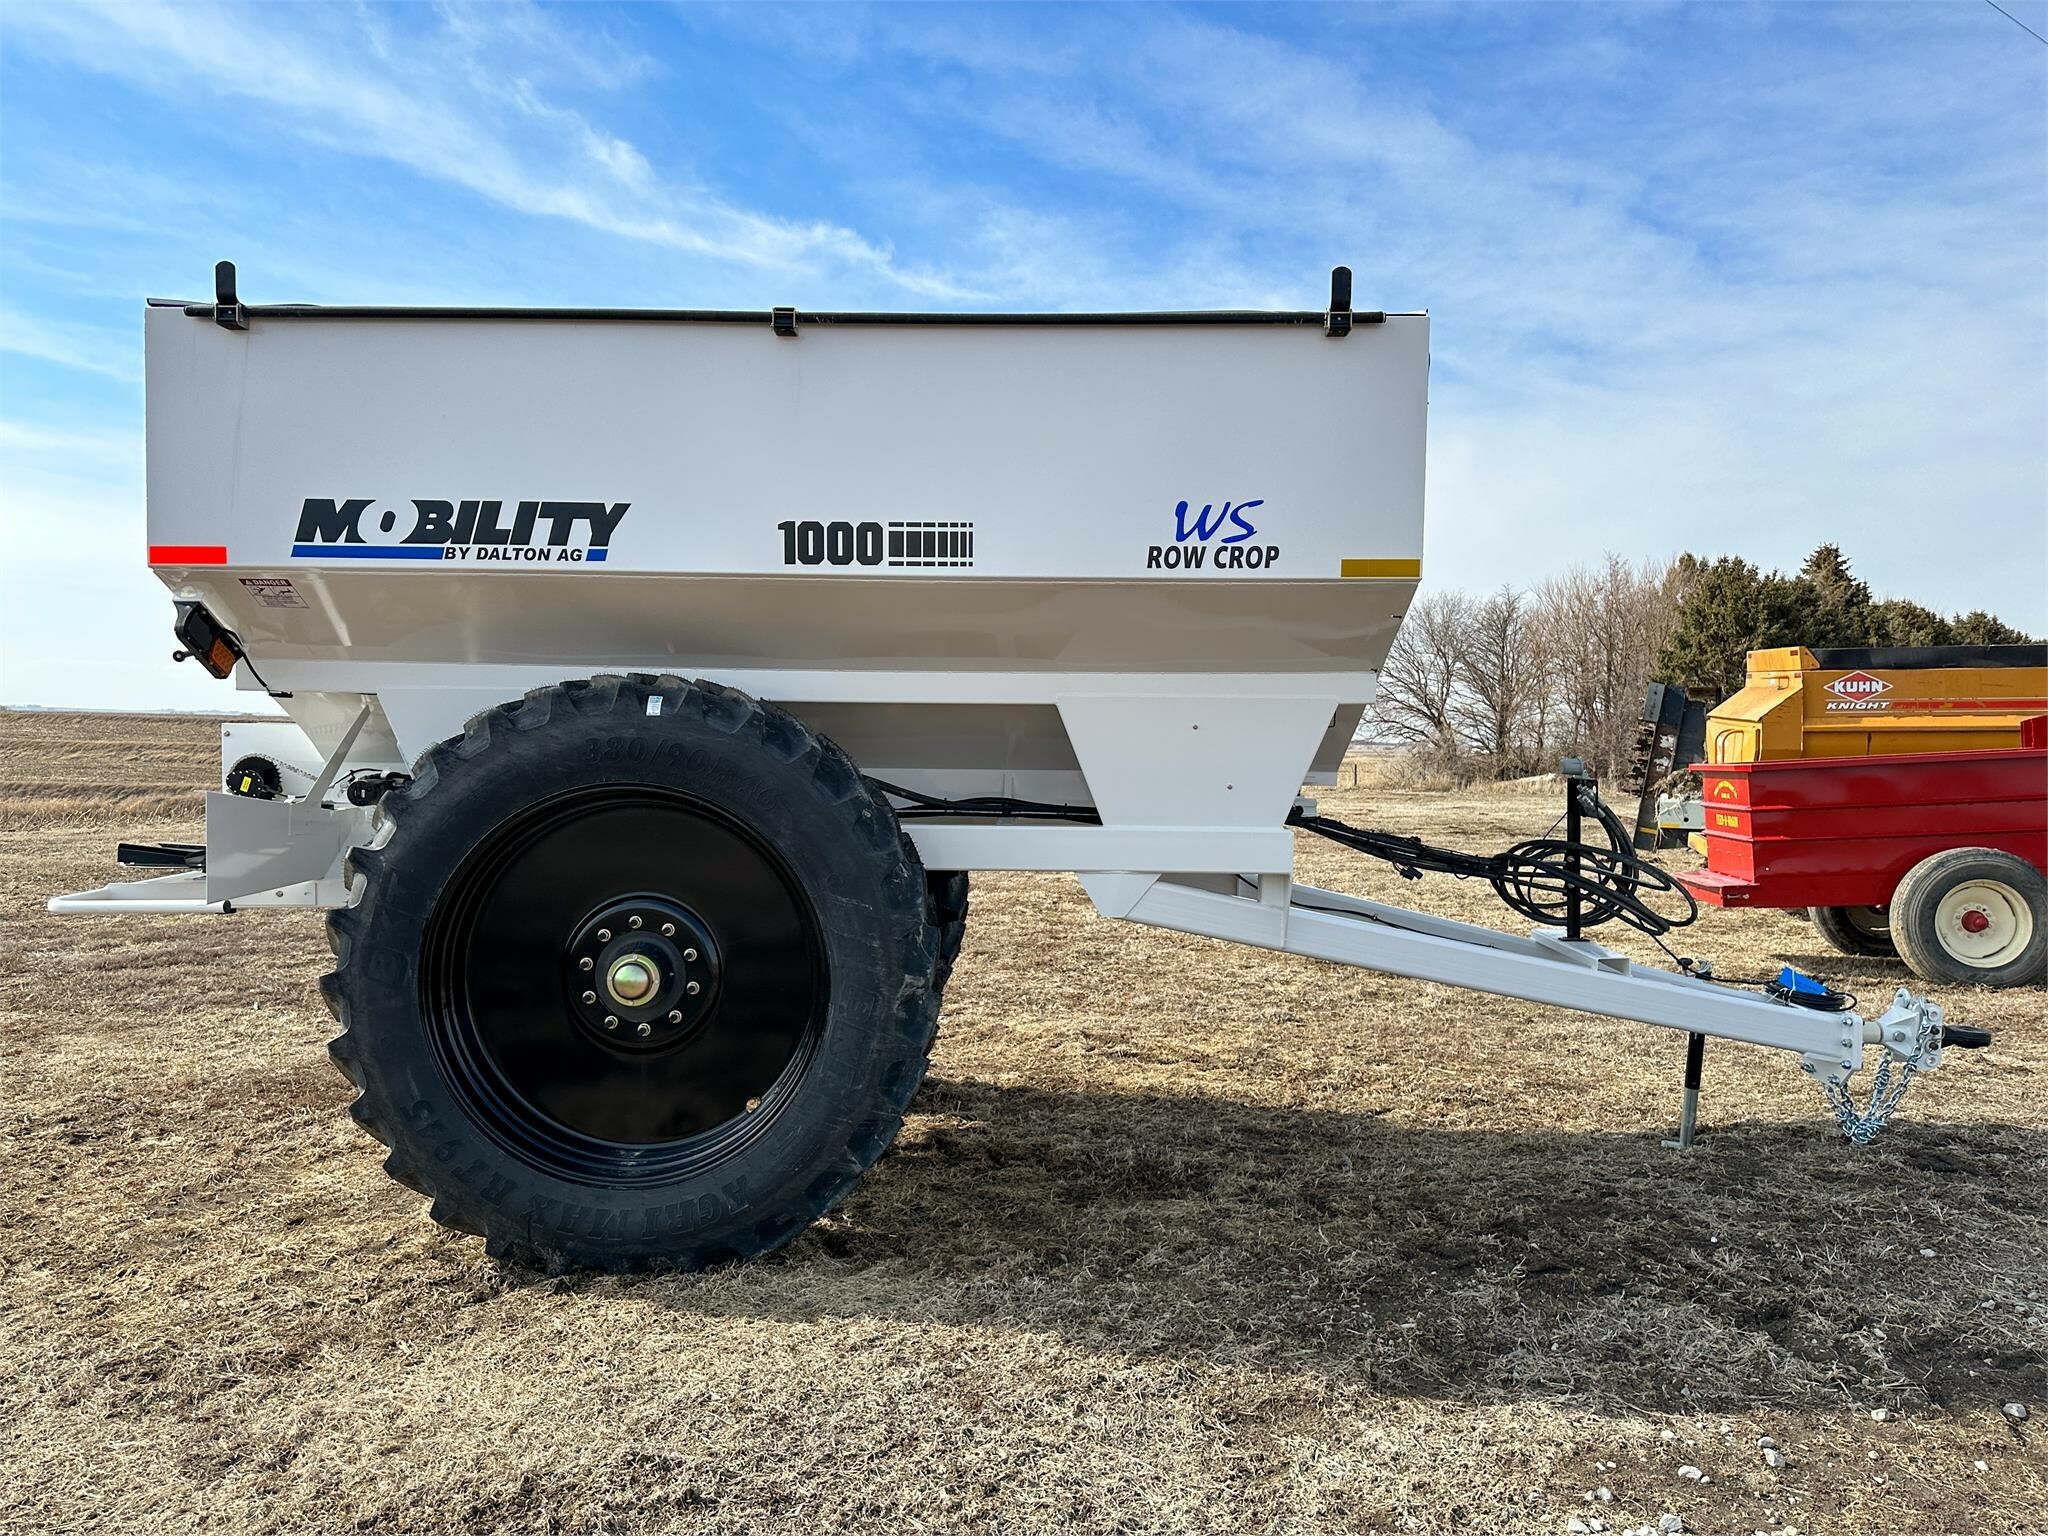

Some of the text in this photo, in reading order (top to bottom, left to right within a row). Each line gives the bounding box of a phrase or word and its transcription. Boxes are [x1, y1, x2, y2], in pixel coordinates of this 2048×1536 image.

[294, 498, 631, 547] MOBILITY
[1175, 499, 1264, 544] WS
[444, 546, 583, 562] BY DALTON AG
[778, 521, 883, 566] 1000
[1147, 545, 1280, 570] ROW CROP
[1834, 680, 1883, 693] KUHN
[1826, 702, 1890, 710] KNIGHT
